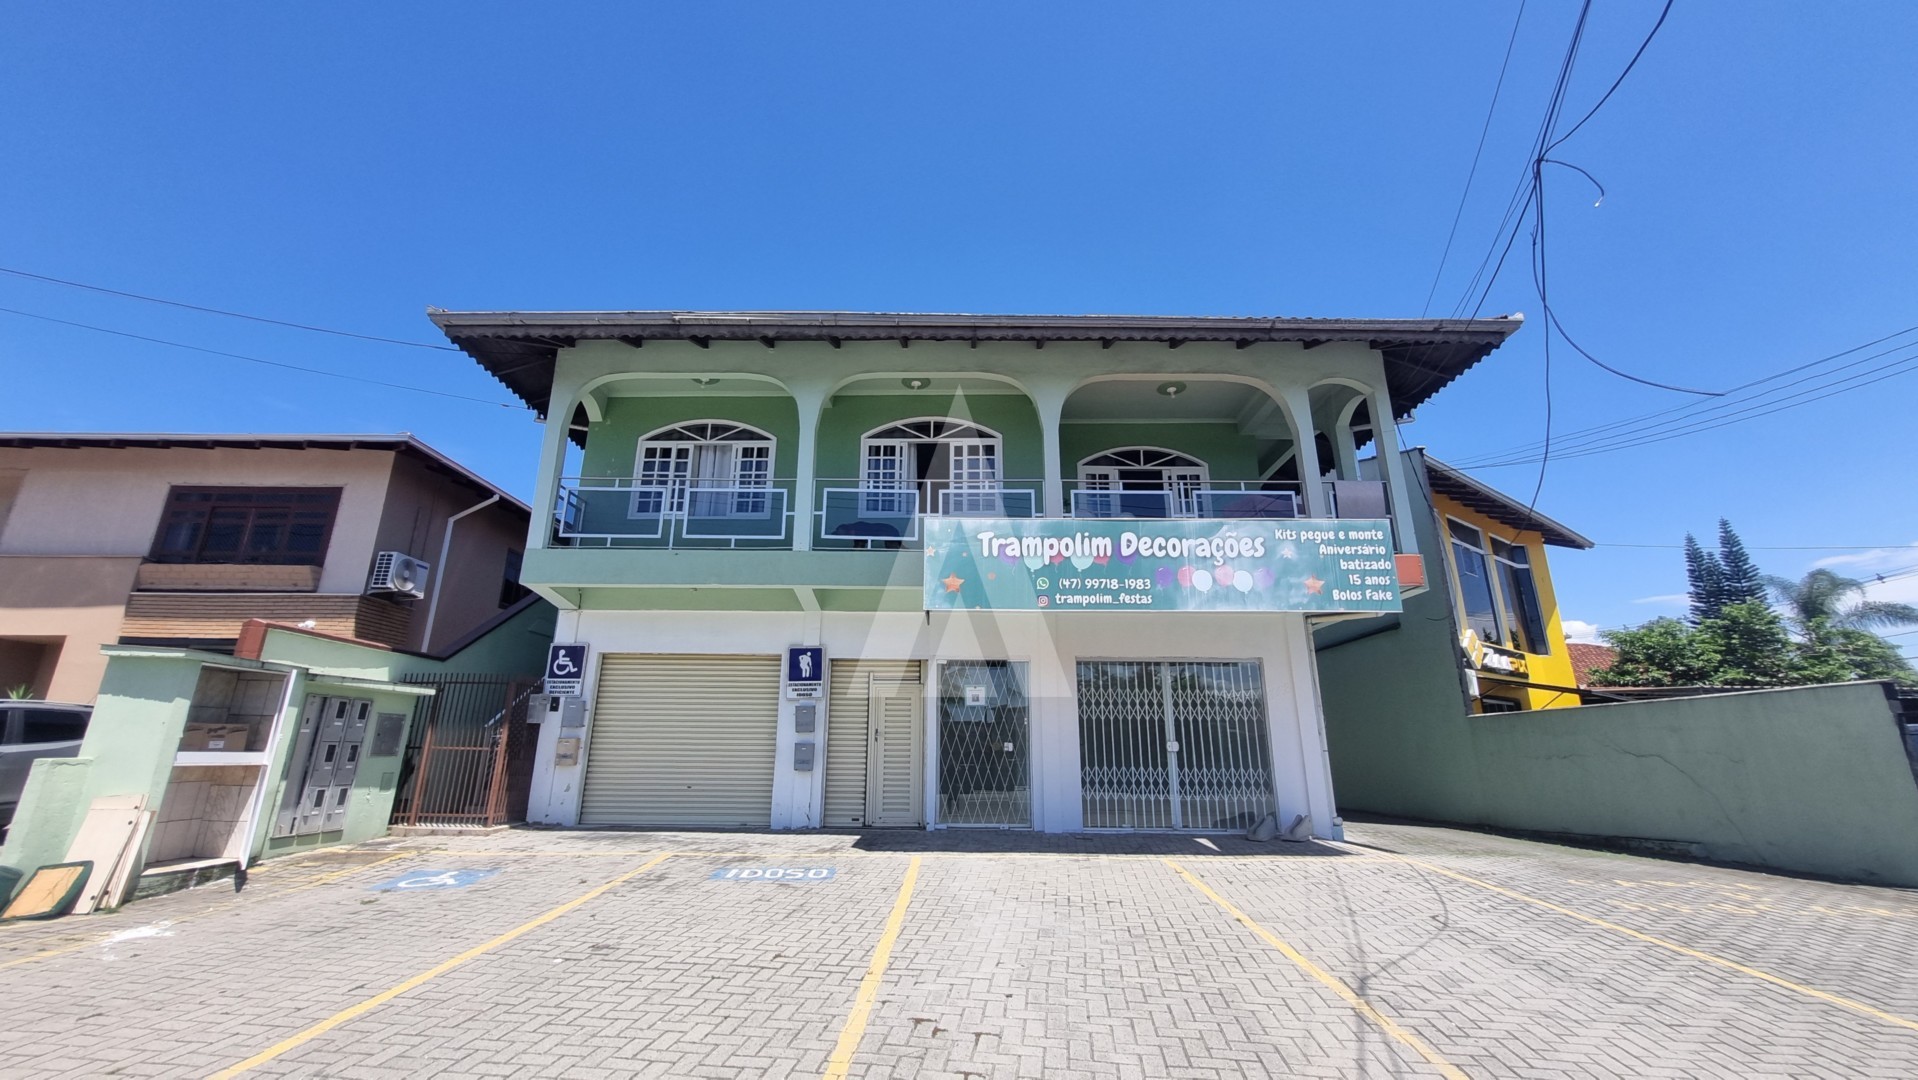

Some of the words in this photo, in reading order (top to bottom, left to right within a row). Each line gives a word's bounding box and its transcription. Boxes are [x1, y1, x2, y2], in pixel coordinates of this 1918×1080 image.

[1274, 528, 1297, 540] Kits
[1300, 529, 1336, 544] pegue
[1338, 530, 1346, 540] e
[1348, 529, 1384, 540] monte
[977, 531, 1112, 565] Trampolim
[1120, 531, 1265, 566] Decorações
[1319, 543, 1386, 555] Aniversário
[1339, 558, 1392, 570] batizado
[1058, 578, 1081, 590] (47)
[1084, 578, 1152, 590] 99718-1983
[1348, 574, 1362, 585] 15
[1364, 575, 1391, 586] anos
[1055, 592, 1153, 606] trampolim_festas
[1332, 589, 1362, 601] Bolos
[1365, 589, 1394, 601] Fake
[724, 868, 829, 879] IDOSO
